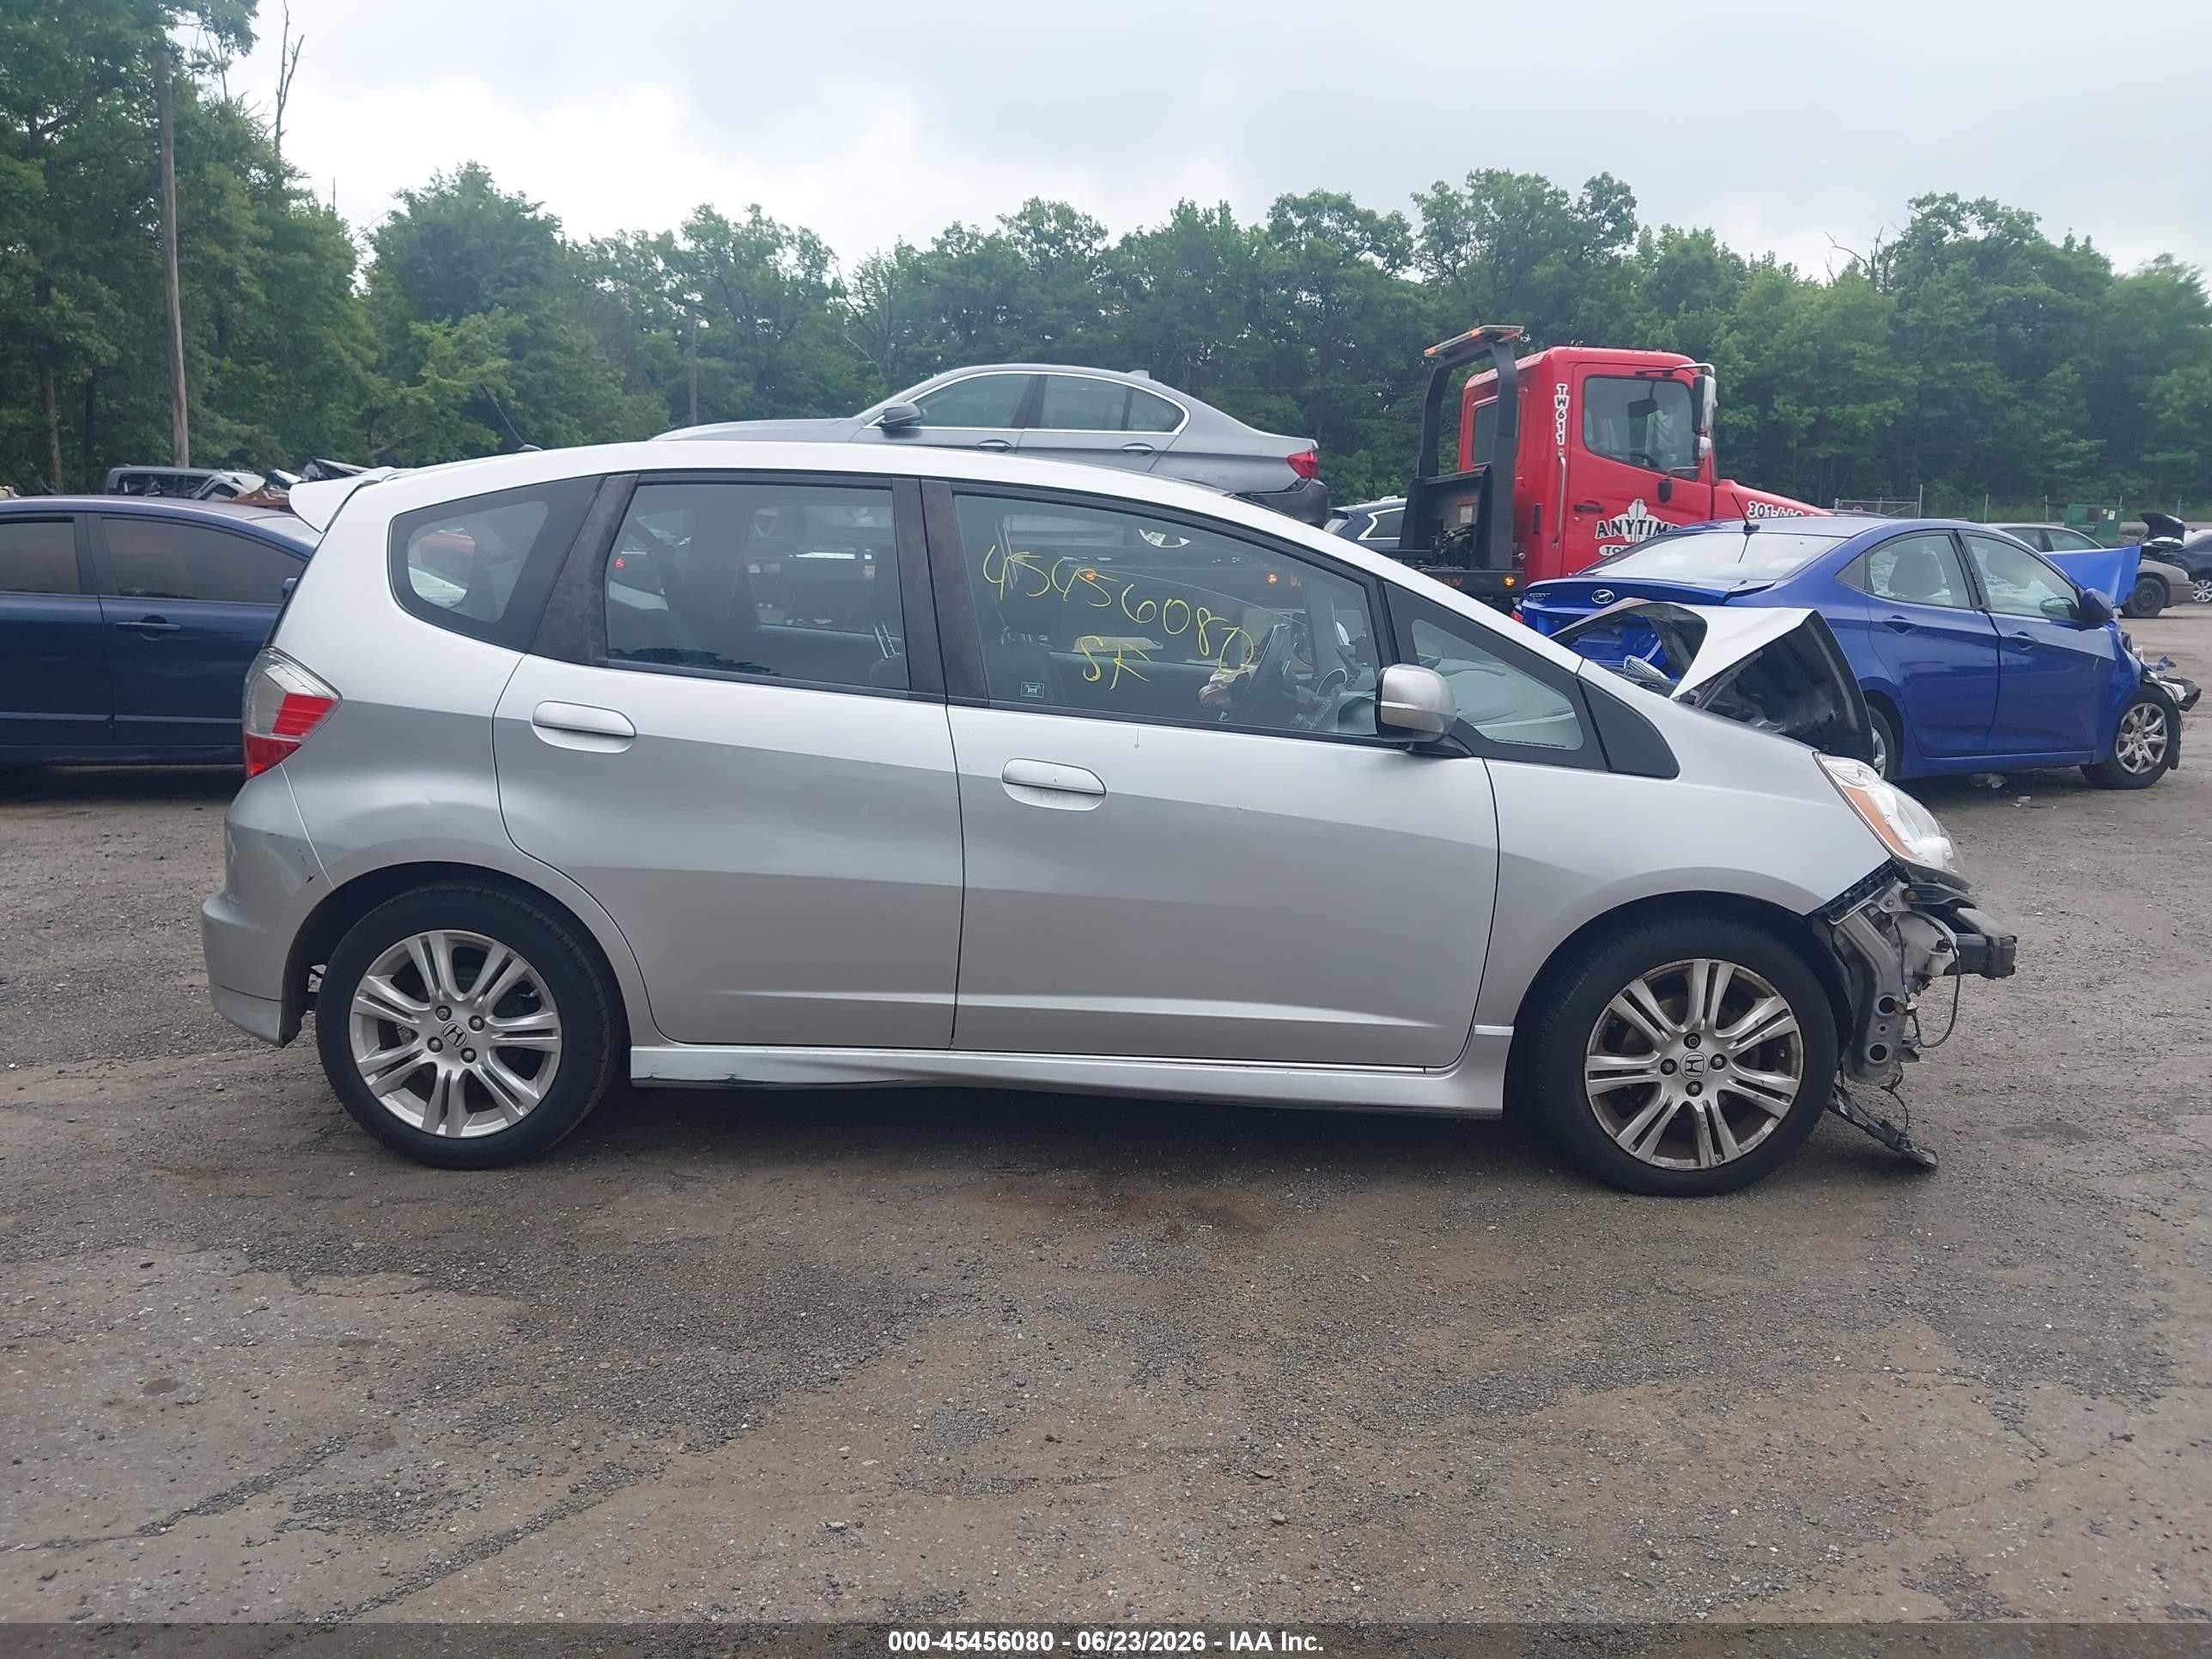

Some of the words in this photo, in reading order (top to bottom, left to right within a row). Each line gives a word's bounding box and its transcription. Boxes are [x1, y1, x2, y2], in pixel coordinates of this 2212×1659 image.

[1555, 384, 1569, 444] TW611
[1747, 501, 1804, 517] 301-44
[1597, 519, 1680, 538] ANYTIM
